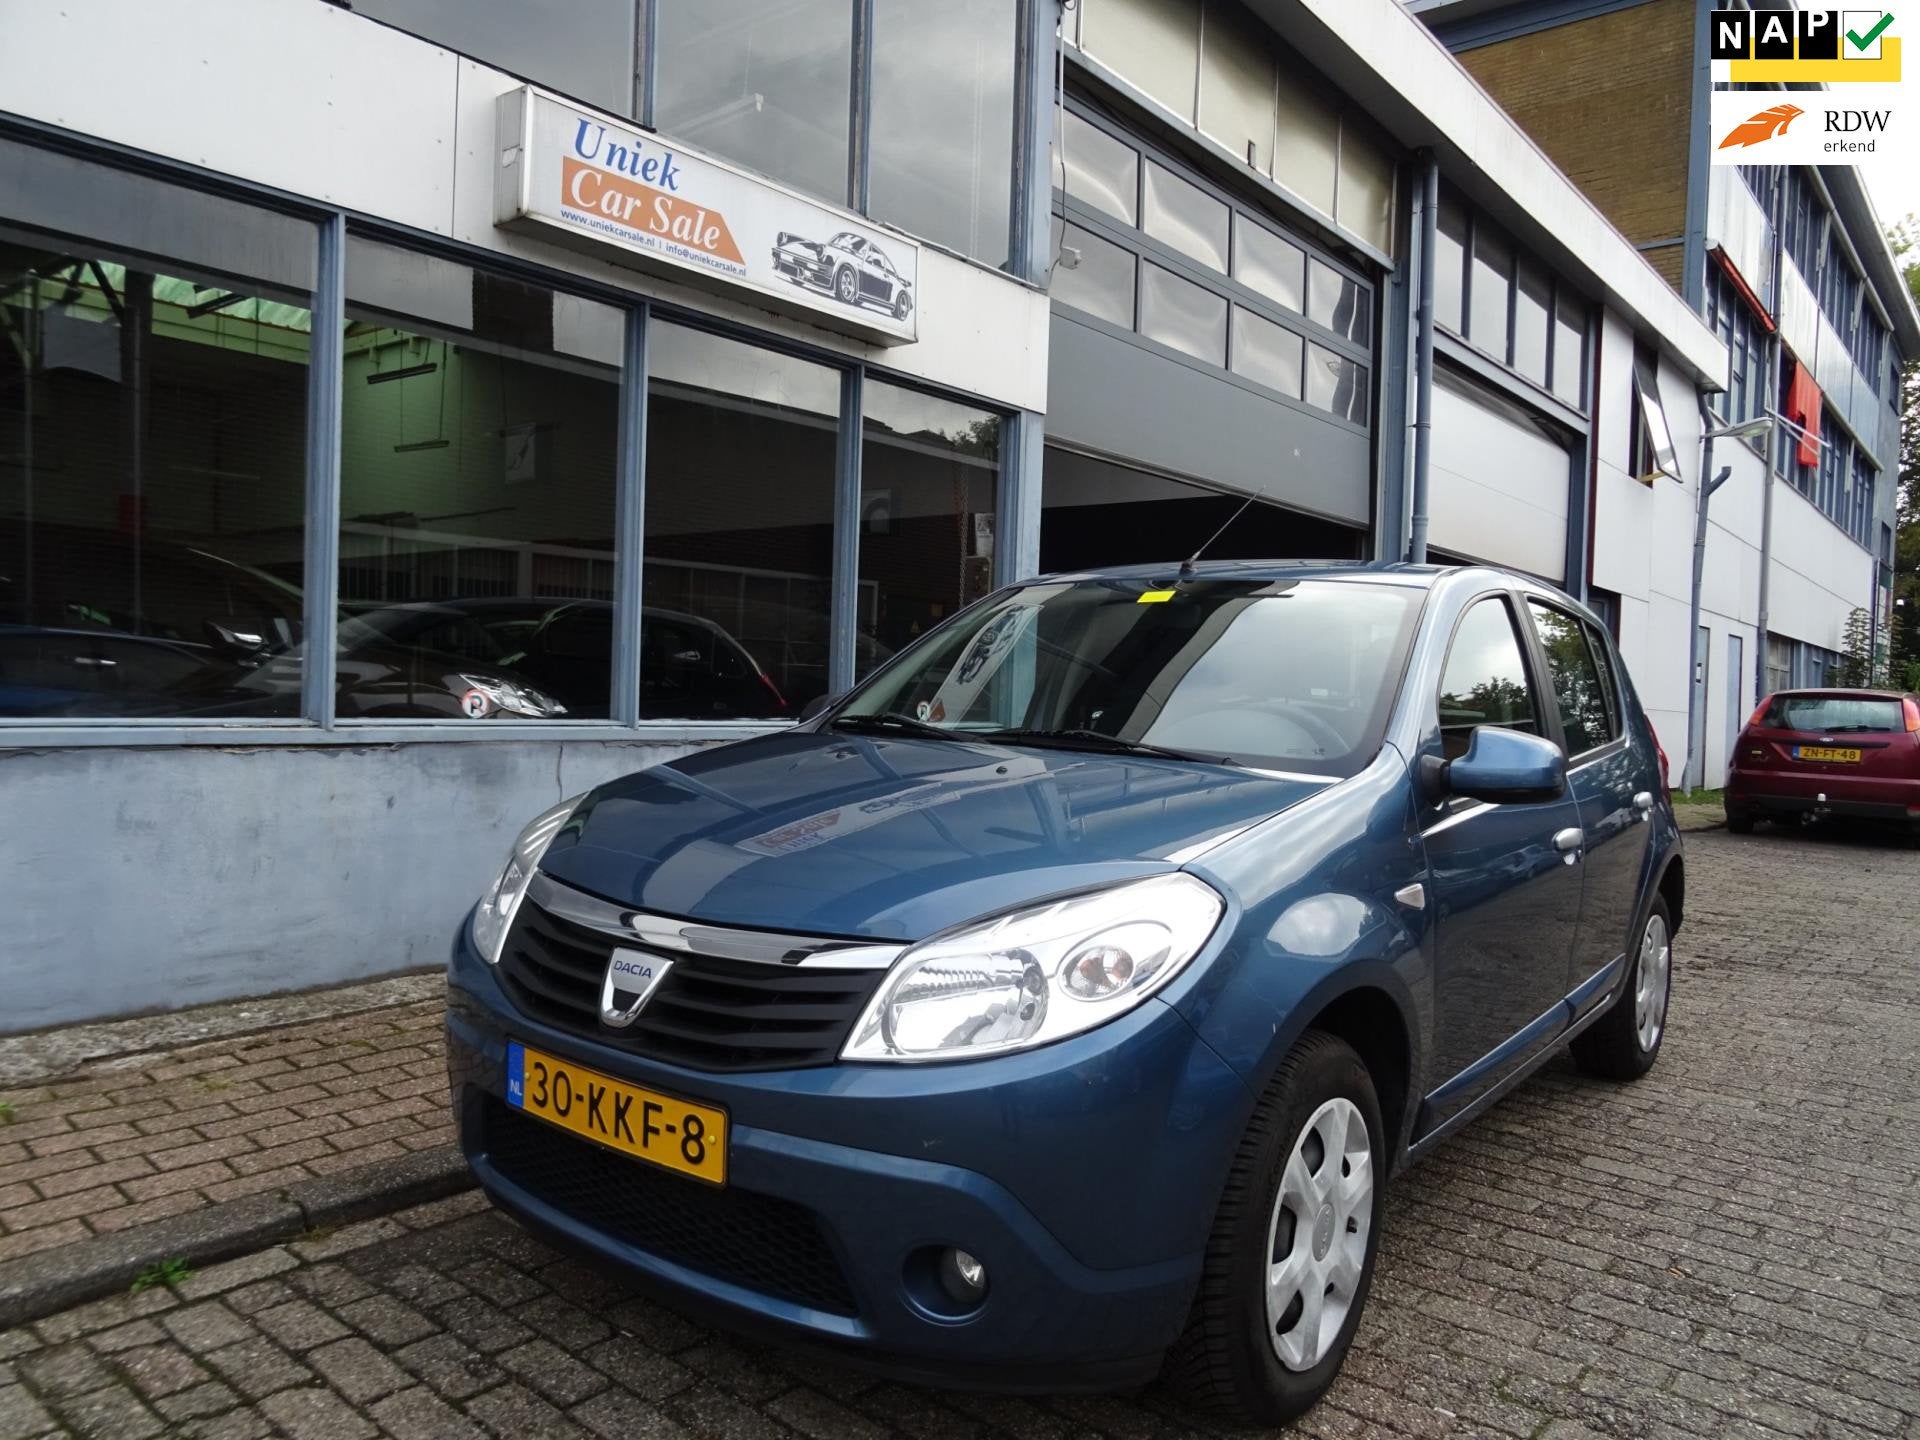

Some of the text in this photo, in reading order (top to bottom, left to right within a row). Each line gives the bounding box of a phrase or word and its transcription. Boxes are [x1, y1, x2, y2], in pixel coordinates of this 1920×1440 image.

[574, 117, 681, 192] Uniek
[560, 208, 655, 247] www.uniekcarsale.nl
[665, 243, 747, 277] info@uniekcarsale.nl
[571, 168, 721, 250] Car Sale
[1802, 747, 1857, 760] ZN-FT-48
[613, 959, 653, 979] DACIA
[510, 1061, 707, 1166] NL 30-KKF-8
